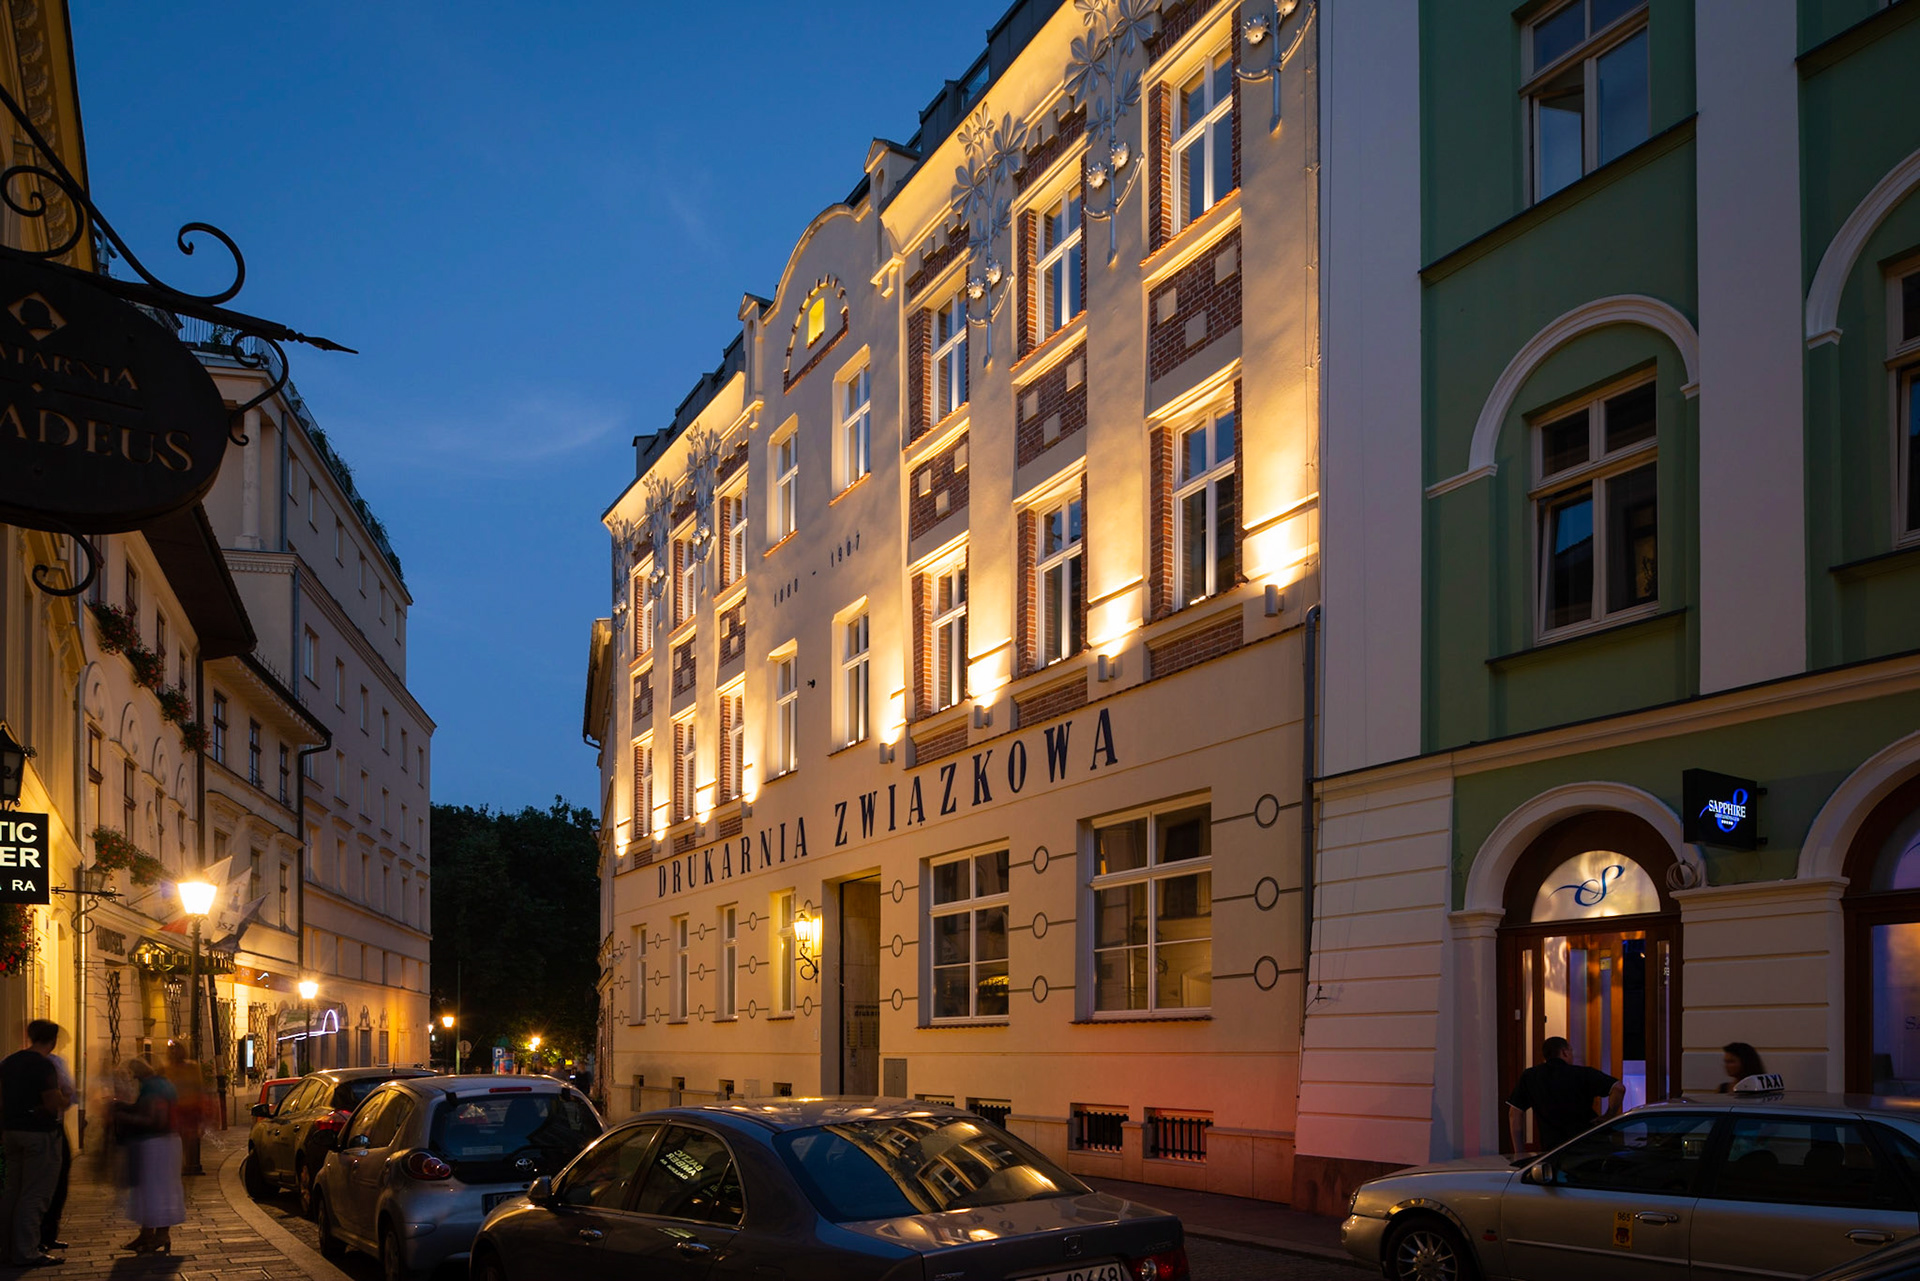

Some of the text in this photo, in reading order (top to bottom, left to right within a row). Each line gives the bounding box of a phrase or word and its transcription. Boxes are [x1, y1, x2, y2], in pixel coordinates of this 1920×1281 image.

[658, 708, 1119, 898] DRUKARNIA ZWIĄZKOWA
[1708, 799, 1747, 819] SAPPHIRE
[12, 879, 36, 892] RA
[495, 1048, 503, 1058] P
[1757, 1074, 1784, 1089] TAXI
[1617, 1212, 1631, 1222] 965
